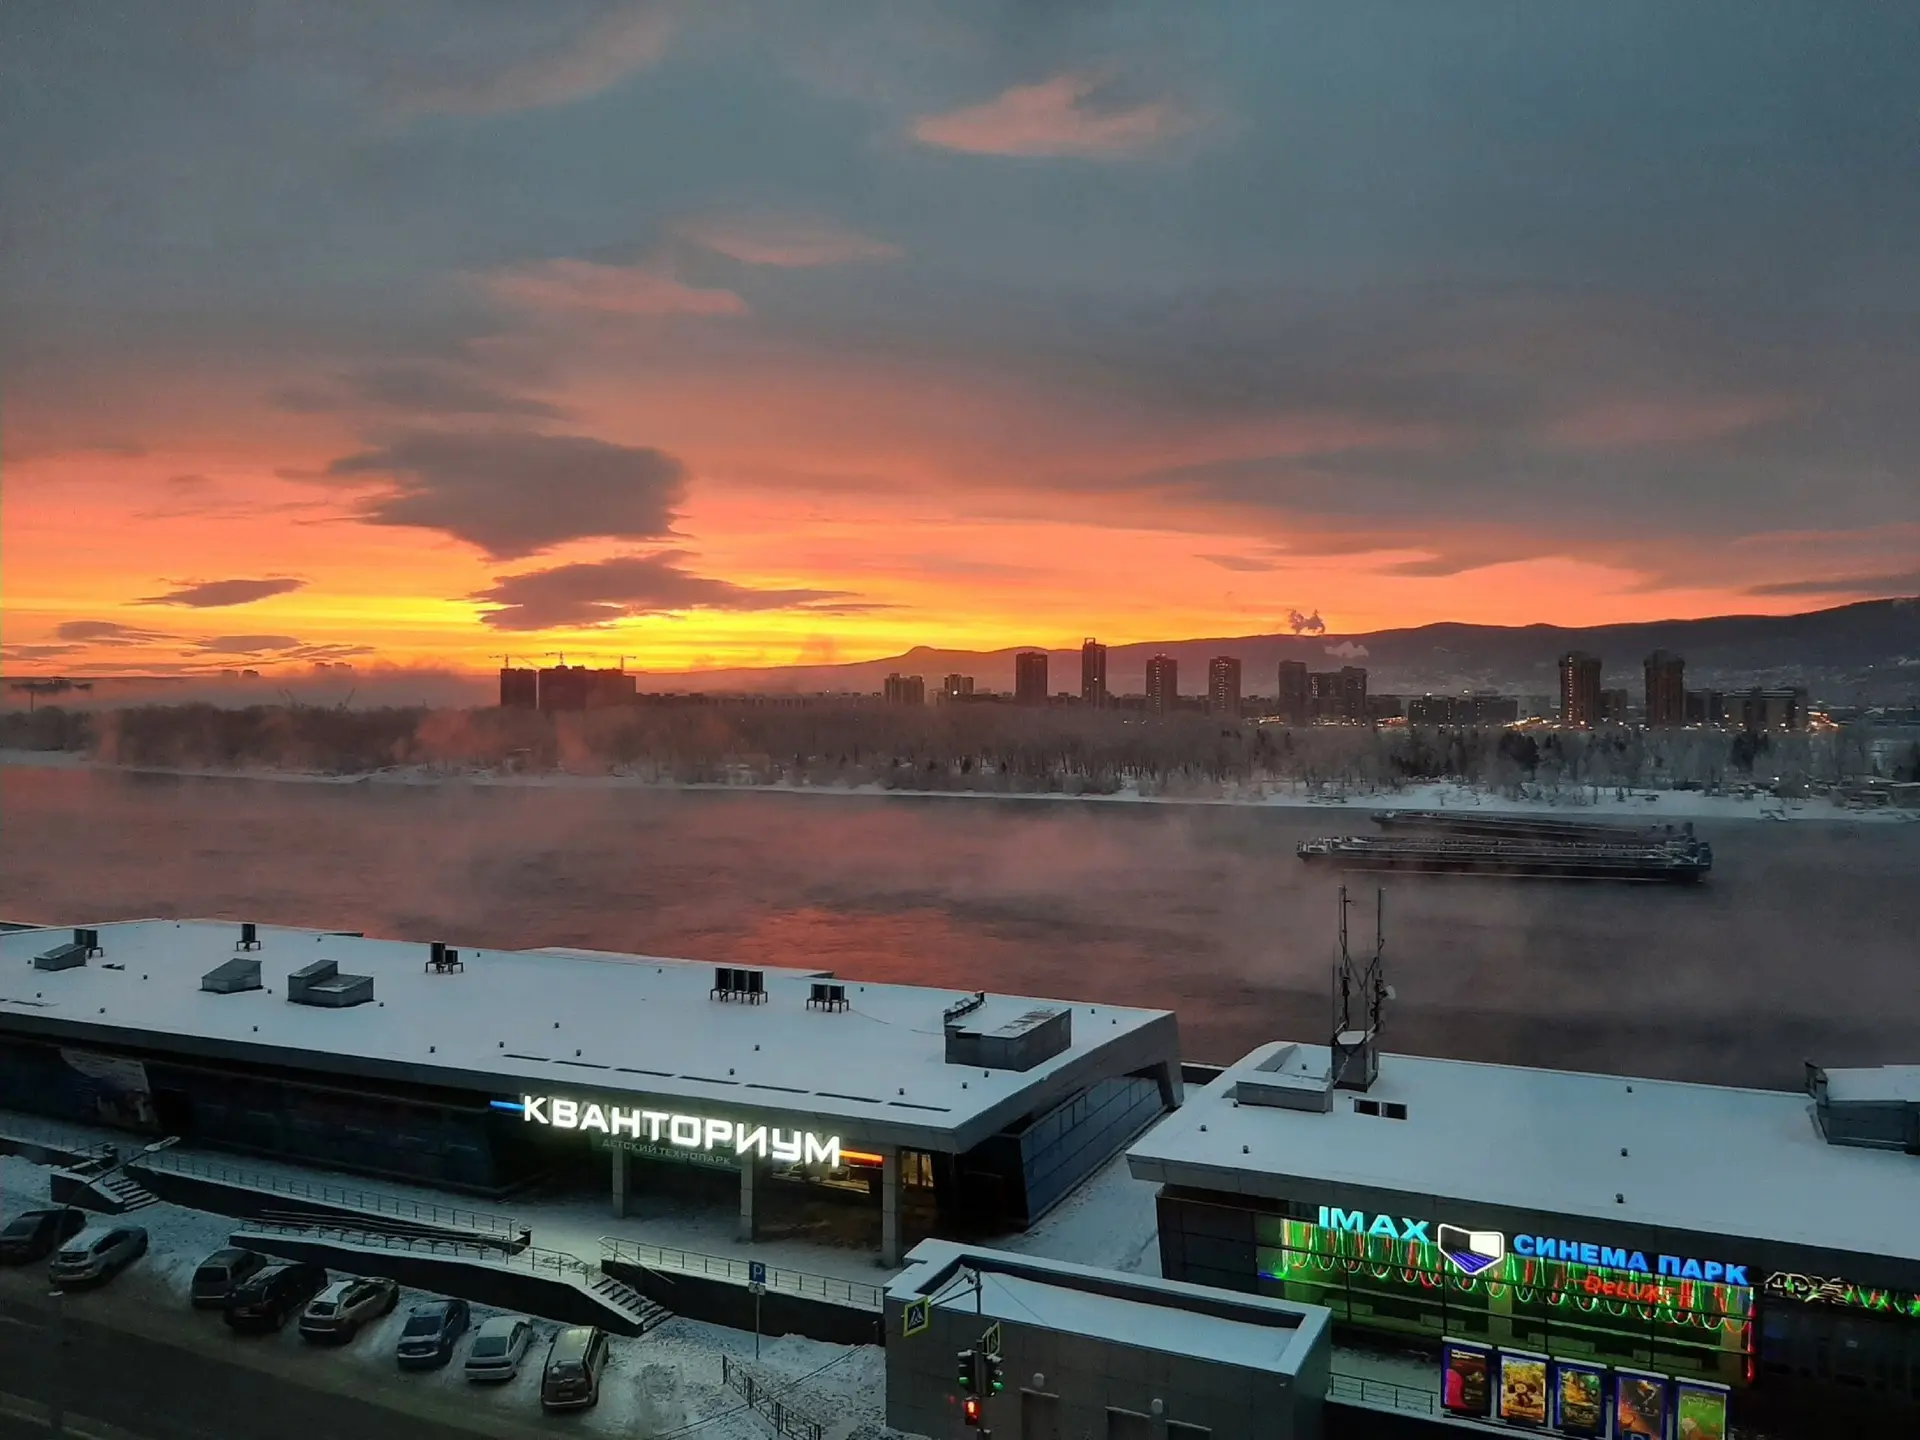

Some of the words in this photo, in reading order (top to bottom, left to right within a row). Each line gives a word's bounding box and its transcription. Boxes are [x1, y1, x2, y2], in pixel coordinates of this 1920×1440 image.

[524, 1096, 840, 1168] КВАНТОРИУМ
[602, 1139, 657, 1155] ДЕТСКИЙ
[659, 1147, 731, 1165] ТЕХНОПАРК
[1319, 1206, 1430, 1244] IMAX
[1514, 1235, 1648, 1273] СИНЕМА
[1658, 1255, 1748, 1286] ПАРК
